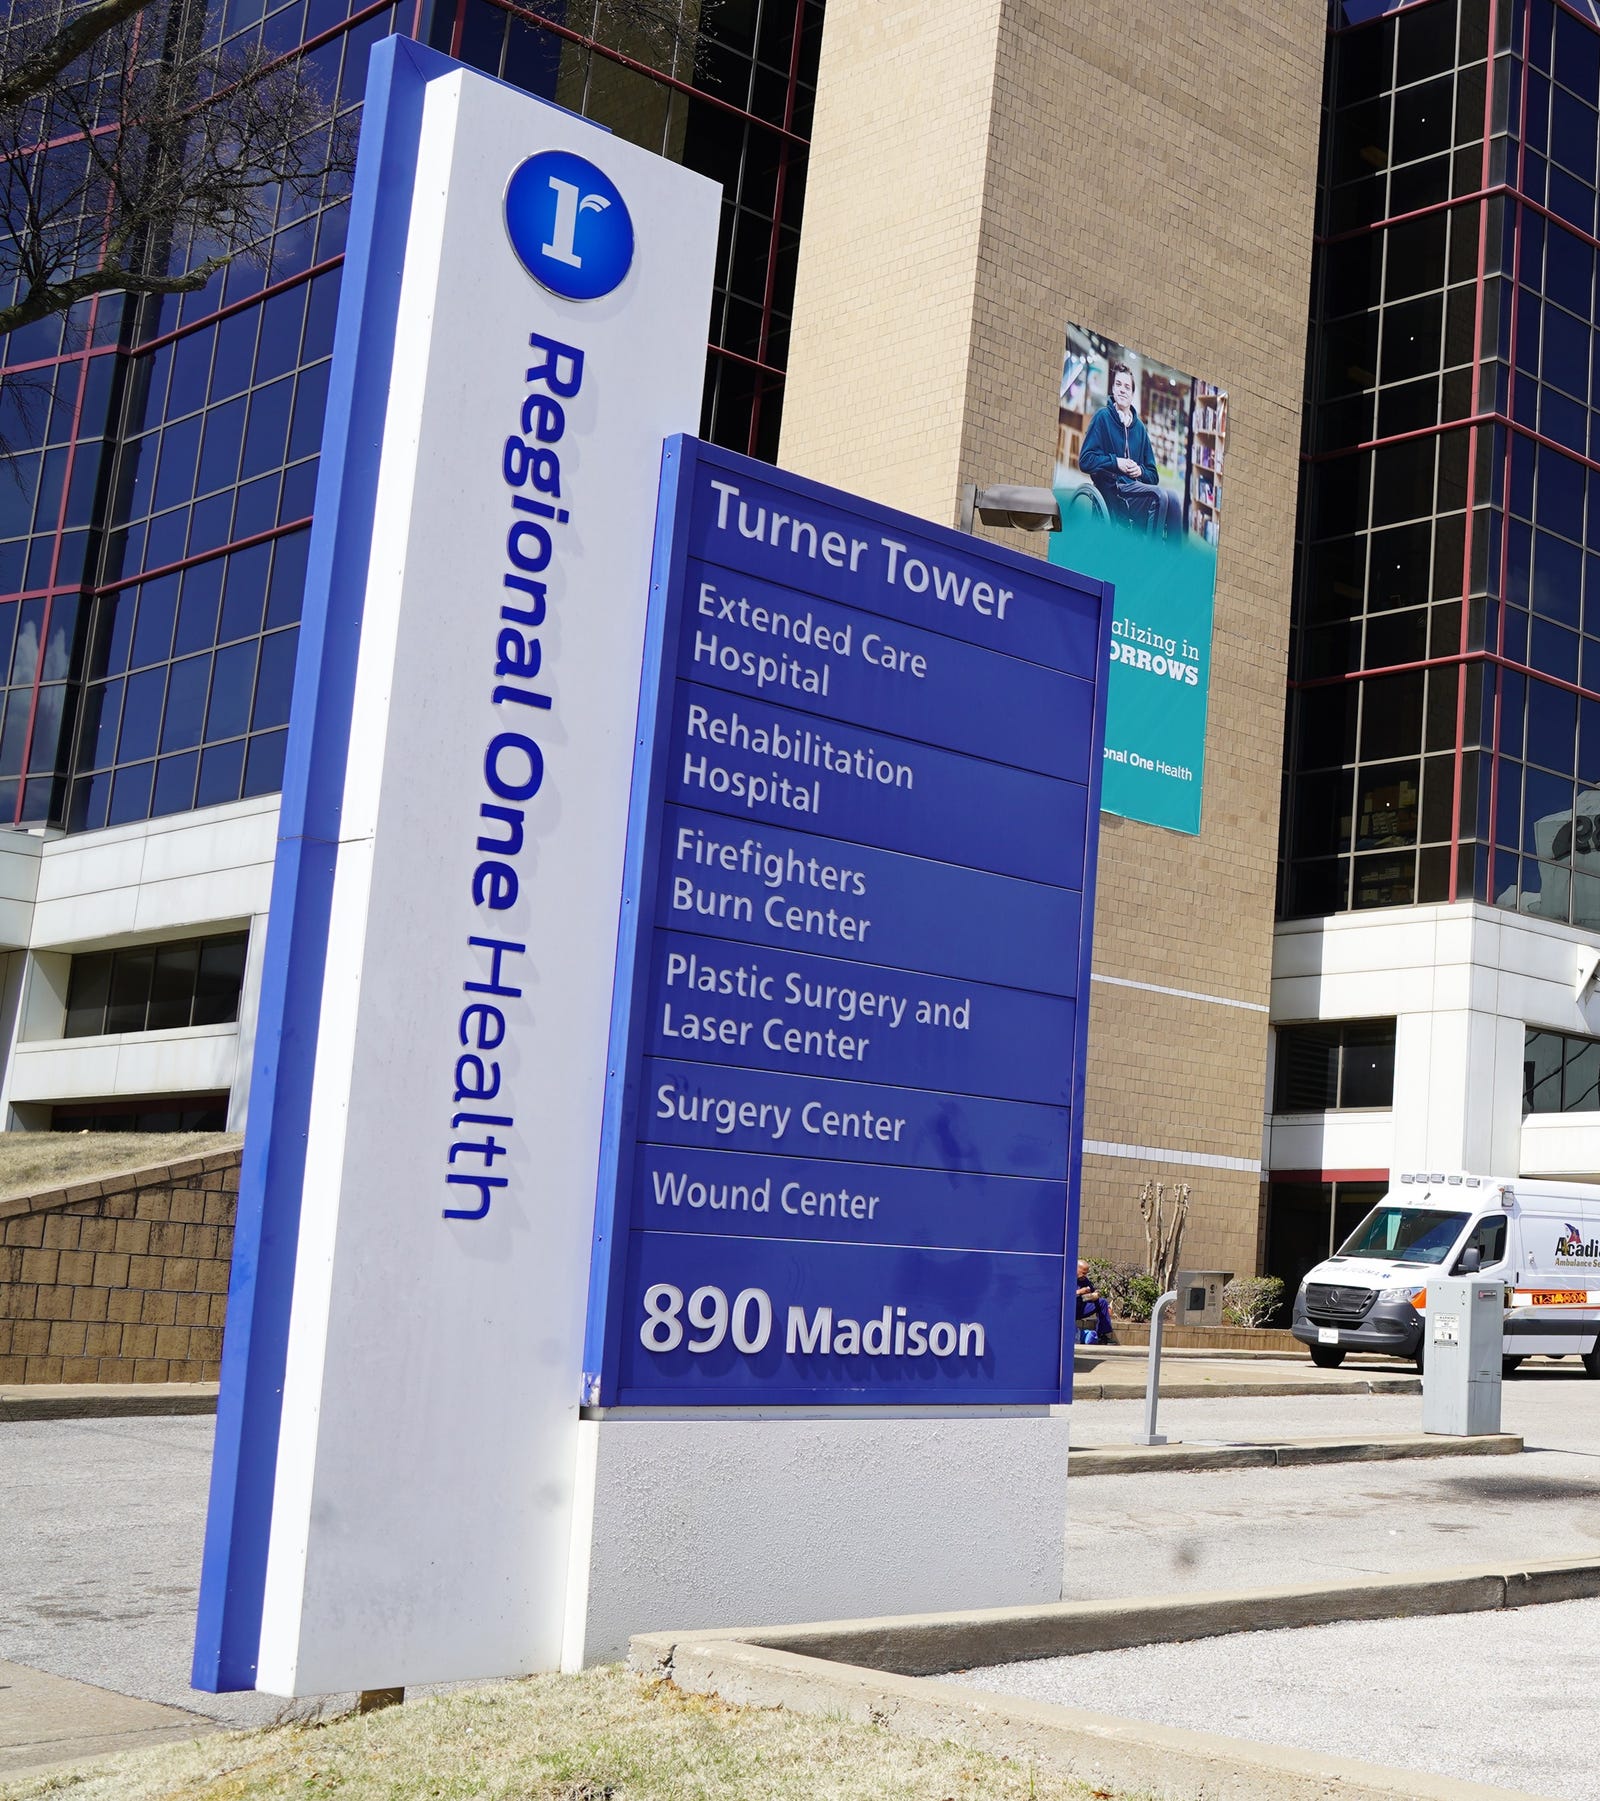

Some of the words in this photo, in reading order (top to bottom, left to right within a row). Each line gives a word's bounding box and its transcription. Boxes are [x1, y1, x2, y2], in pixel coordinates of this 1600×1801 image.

[491, 332, 584, 711] Regional
[710, 478, 868, 573] Turner
[881, 537, 1014, 620] Tower
[694, 630, 830, 697] Hospital
[698, 582, 852, 656] Extended
[862, 634, 927, 679] Care
[1182, 640, 1200, 661] in
[688, 703, 913, 790] Rehabilitation
[1129, 753, 1154, 771] One
[1156, 760, 1193, 781] Health
[682, 753, 820, 815] Hospital
[472, 731, 544, 911] One
[676, 827, 866, 896] Firefighters
[673, 877, 752, 922] Burn
[764, 895, 871, 943] Center
[667, 952, 774, 1002] Plastic
[785, 971, 907, 1029] Surgery
[915, 998, 971, 1031] and
[662, 1003, 752, 1047] Laser
[763, 1017, 870, 1062] Center
[442, 936, 527, 1221] Health
[656, 1083, 791, 1140] Surgery
[801, 1101, 906, 1142] Center
[652, 1170, 770, 1214] Wound
[780, 1181, 880, 1221] Center
[1555, 1258, 1592, 1268] Ambulance
[639, 1282, 773, 1355] 890
[785, 1304, 986, 1358] Madison
